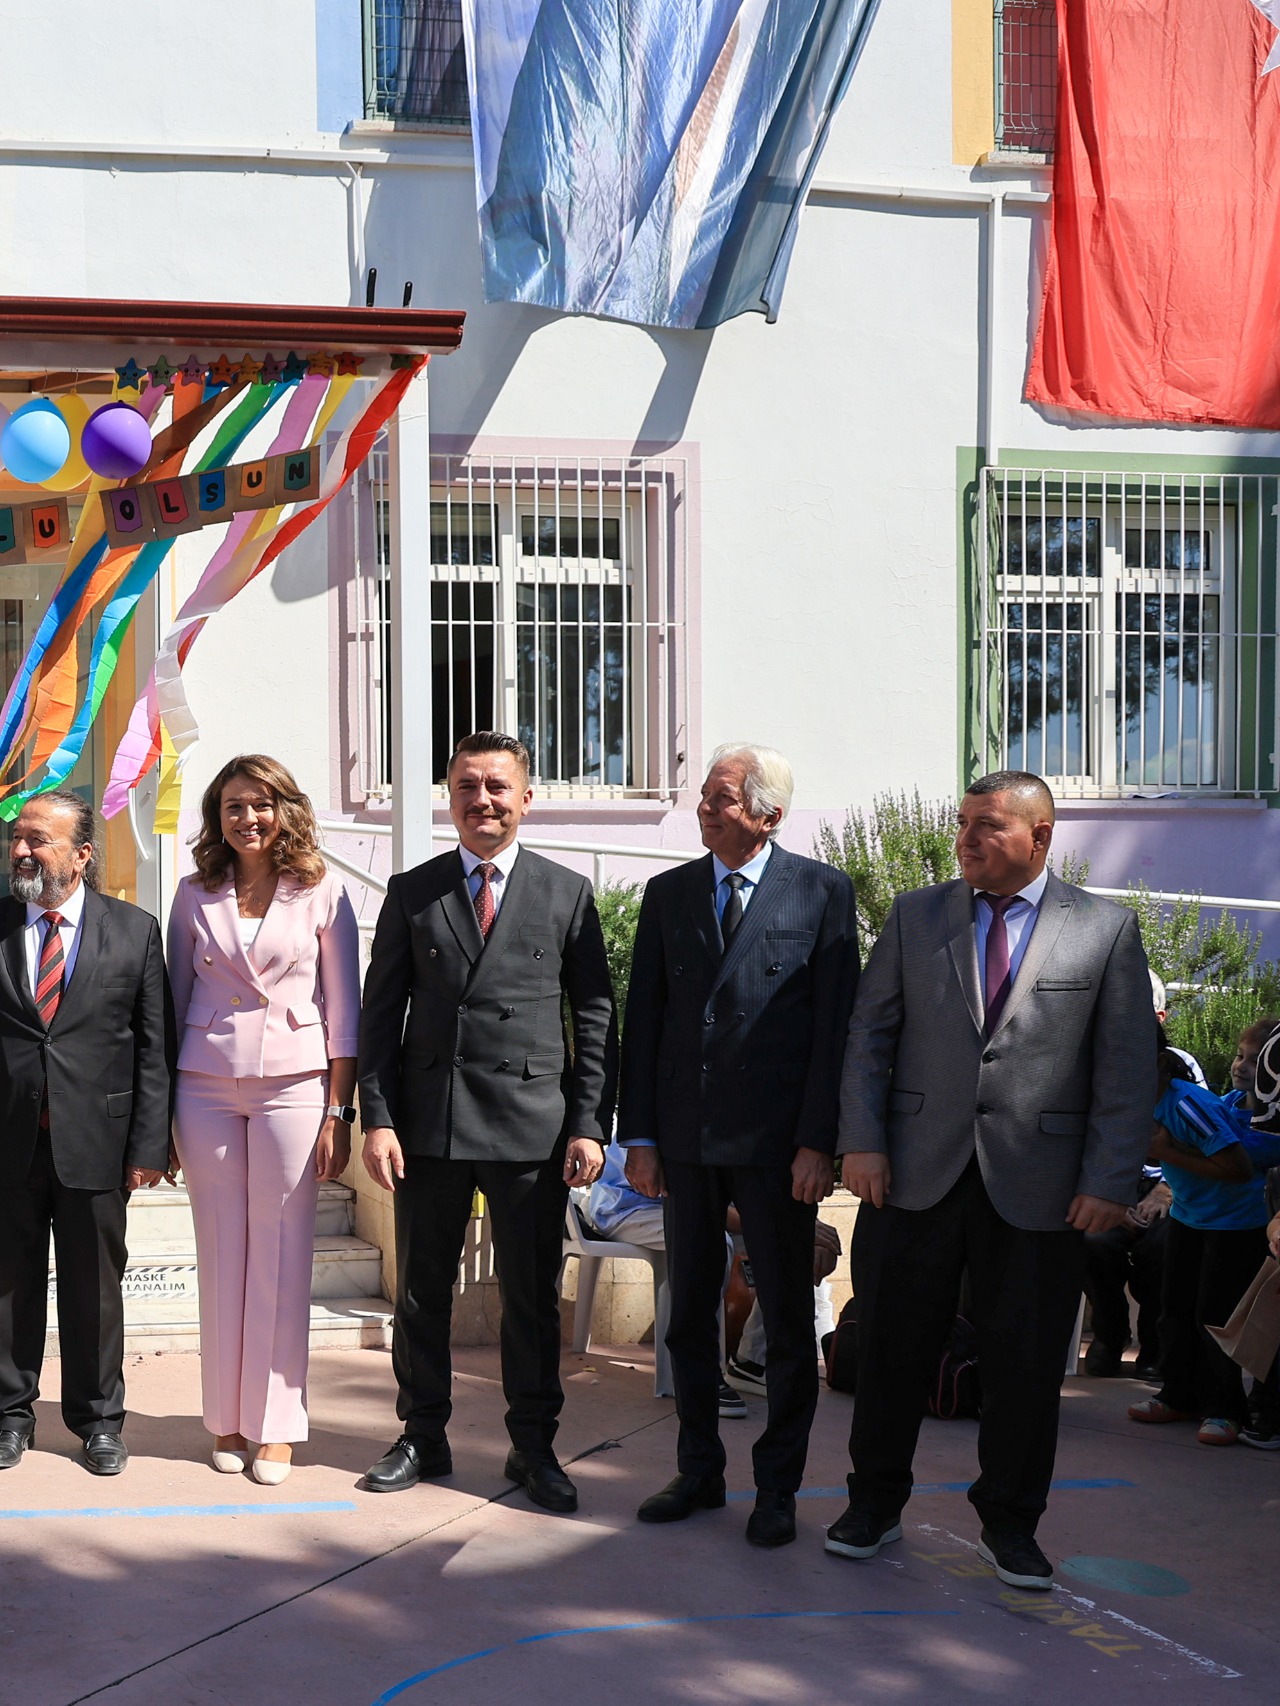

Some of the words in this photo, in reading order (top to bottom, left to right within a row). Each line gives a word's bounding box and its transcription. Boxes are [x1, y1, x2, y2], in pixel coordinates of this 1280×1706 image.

[119, 461, 305, 522] OLSUN
[123, 1273, 166, 1282] MASKE
[120, 1282, 185, 1291] LLANALIM
